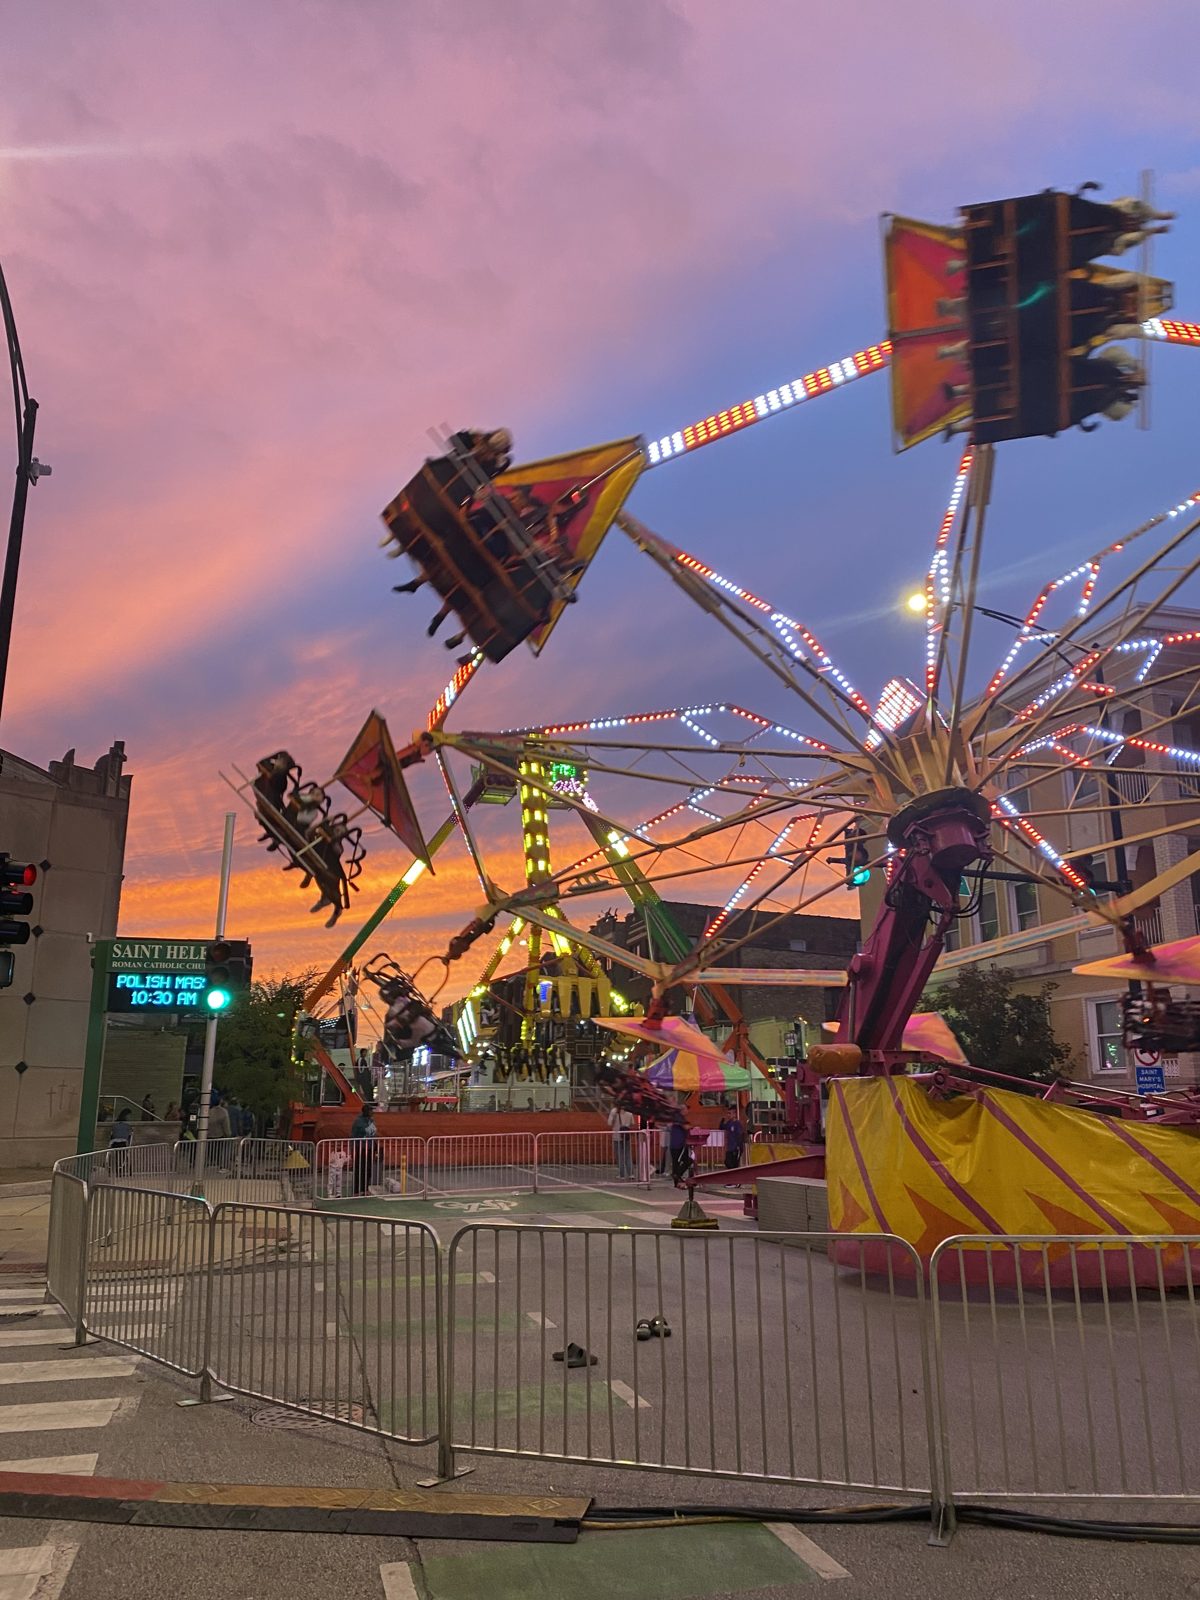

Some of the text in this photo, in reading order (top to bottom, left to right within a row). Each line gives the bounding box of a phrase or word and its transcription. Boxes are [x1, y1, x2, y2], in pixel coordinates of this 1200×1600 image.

[112, 943, 162, 959] SAINT
[143, 961, 186, 970] CATHOLIC
[116, 974, 171, 989] POLISH
[130, 990, 197, 1006] 10:30 AM
